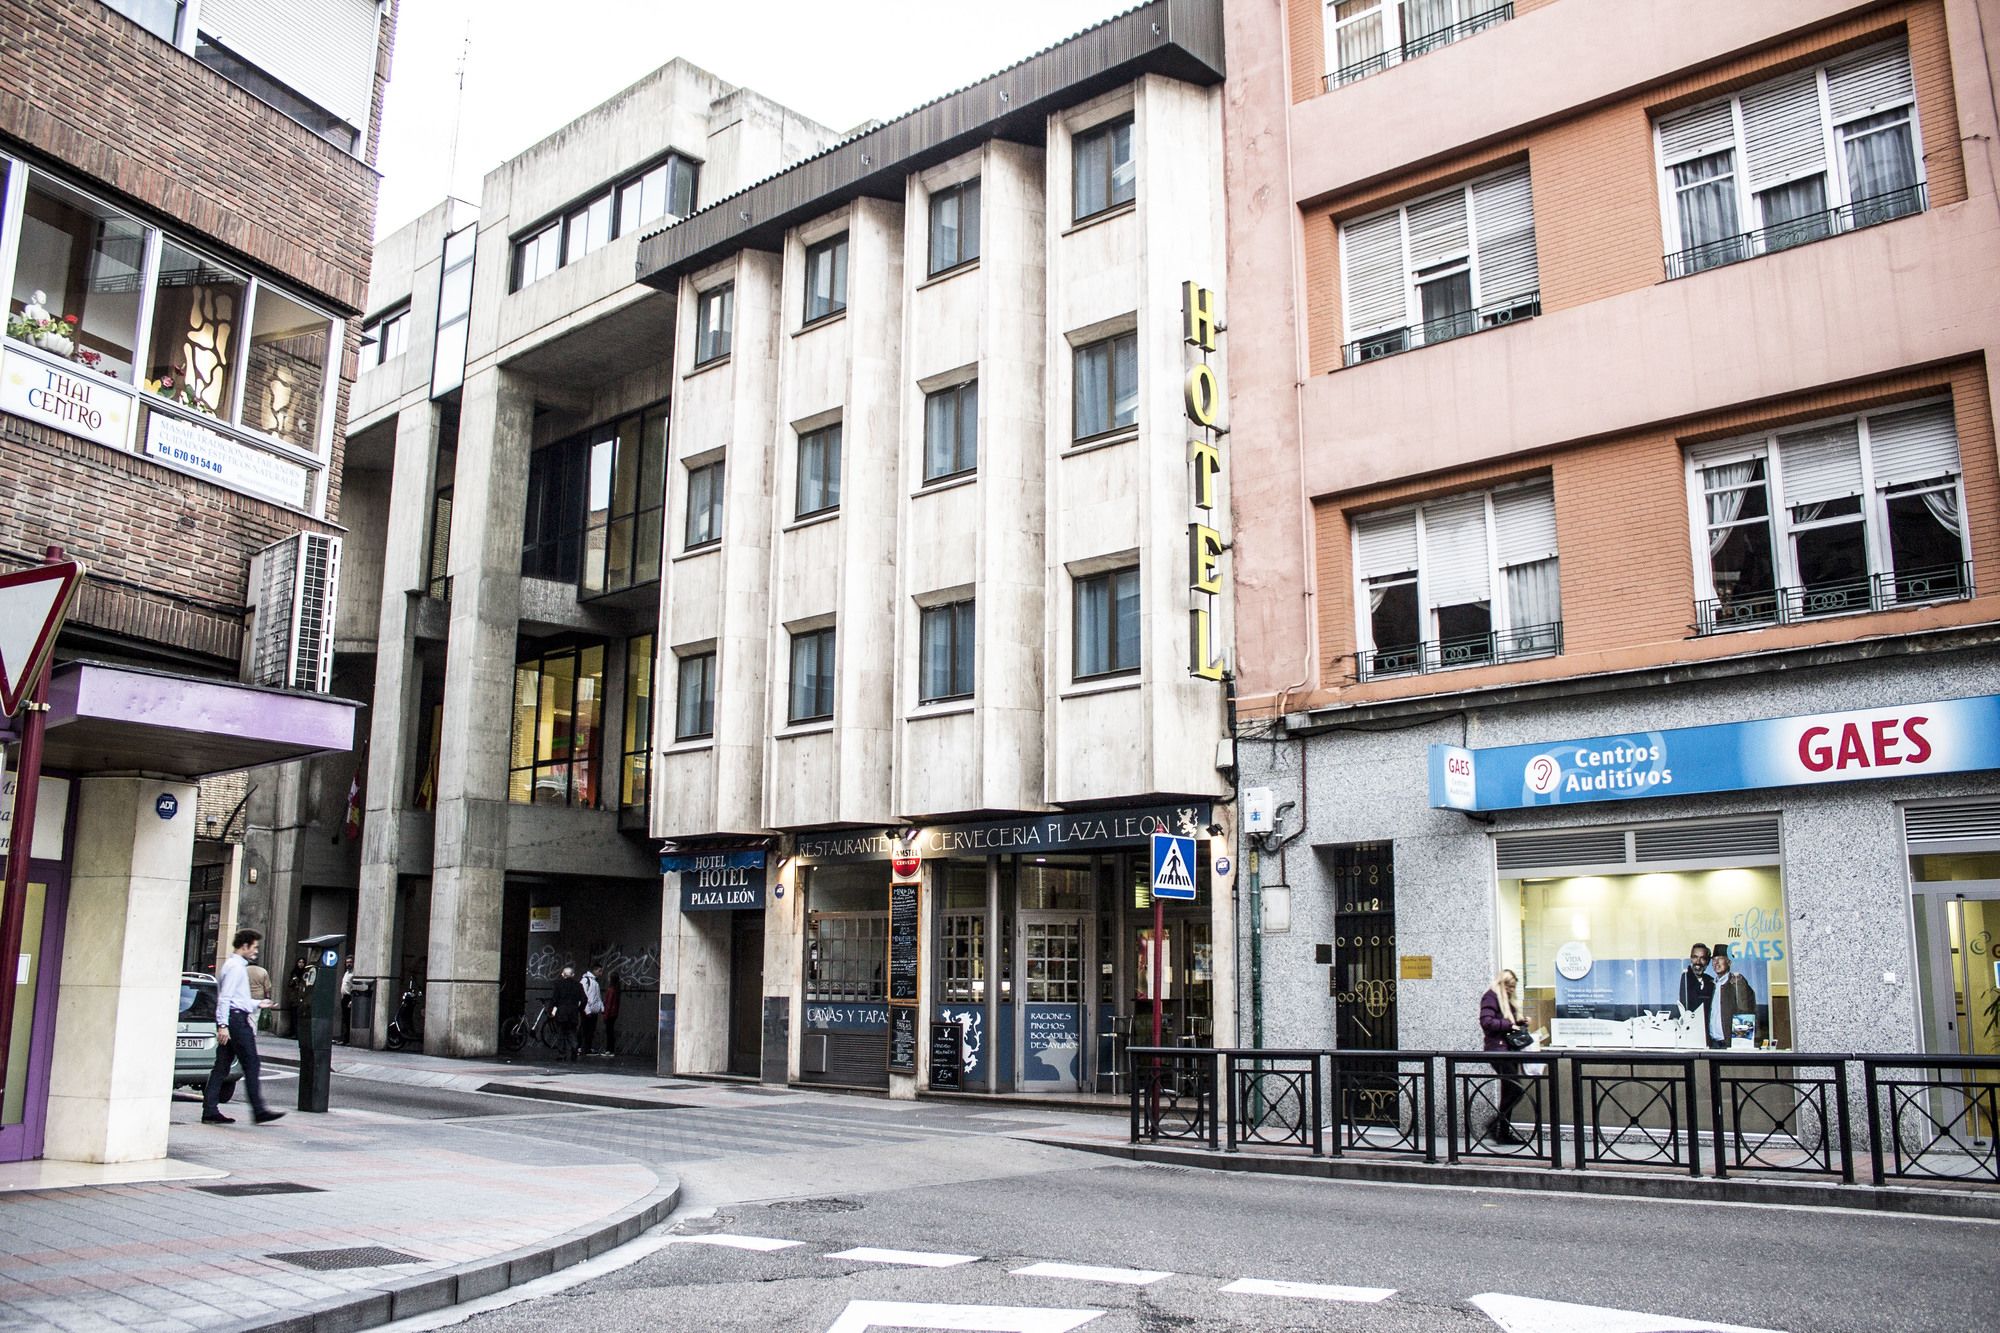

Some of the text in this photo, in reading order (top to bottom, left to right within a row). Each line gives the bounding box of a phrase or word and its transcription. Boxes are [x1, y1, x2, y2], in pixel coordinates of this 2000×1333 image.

[46, 369, 91, 403] THAI
[28, 388, 102, 431] CENTRO
[158, 442, 223, 474] Tel. 670 91 54 40
[1182, 281, 1223, 681] HOTEL
[1798, 716, 1932, 772] GAES
[1448, 758, 1470, 776] GAES
[1575, 746, 1660, 768] Centros
[1566, 768, 1673, 792] Auditivos
[160, 800, 175, 810] ADT
[799, 815, 1170, 858] RESTAURANTE CERVECERIA PLAZA LEON
[695, 855, 727, 869] HOTEL
[896, 848, 918, 858] AMSTEL
[699, 867, 749, 887] HOTEL
[691, 887, 756, 905] PLAZA LEÓN
[1371, 898, 1379, 911] 2
[1727, 907, 1783, 943] mi Club
[1727, 939, 1784, 961] GAES
[807, 1007, 843, 1022] CAÑAS
[847, 1009, 855, 1022] Y
[1031, 1022, 1065, 1030] PINCHOS
